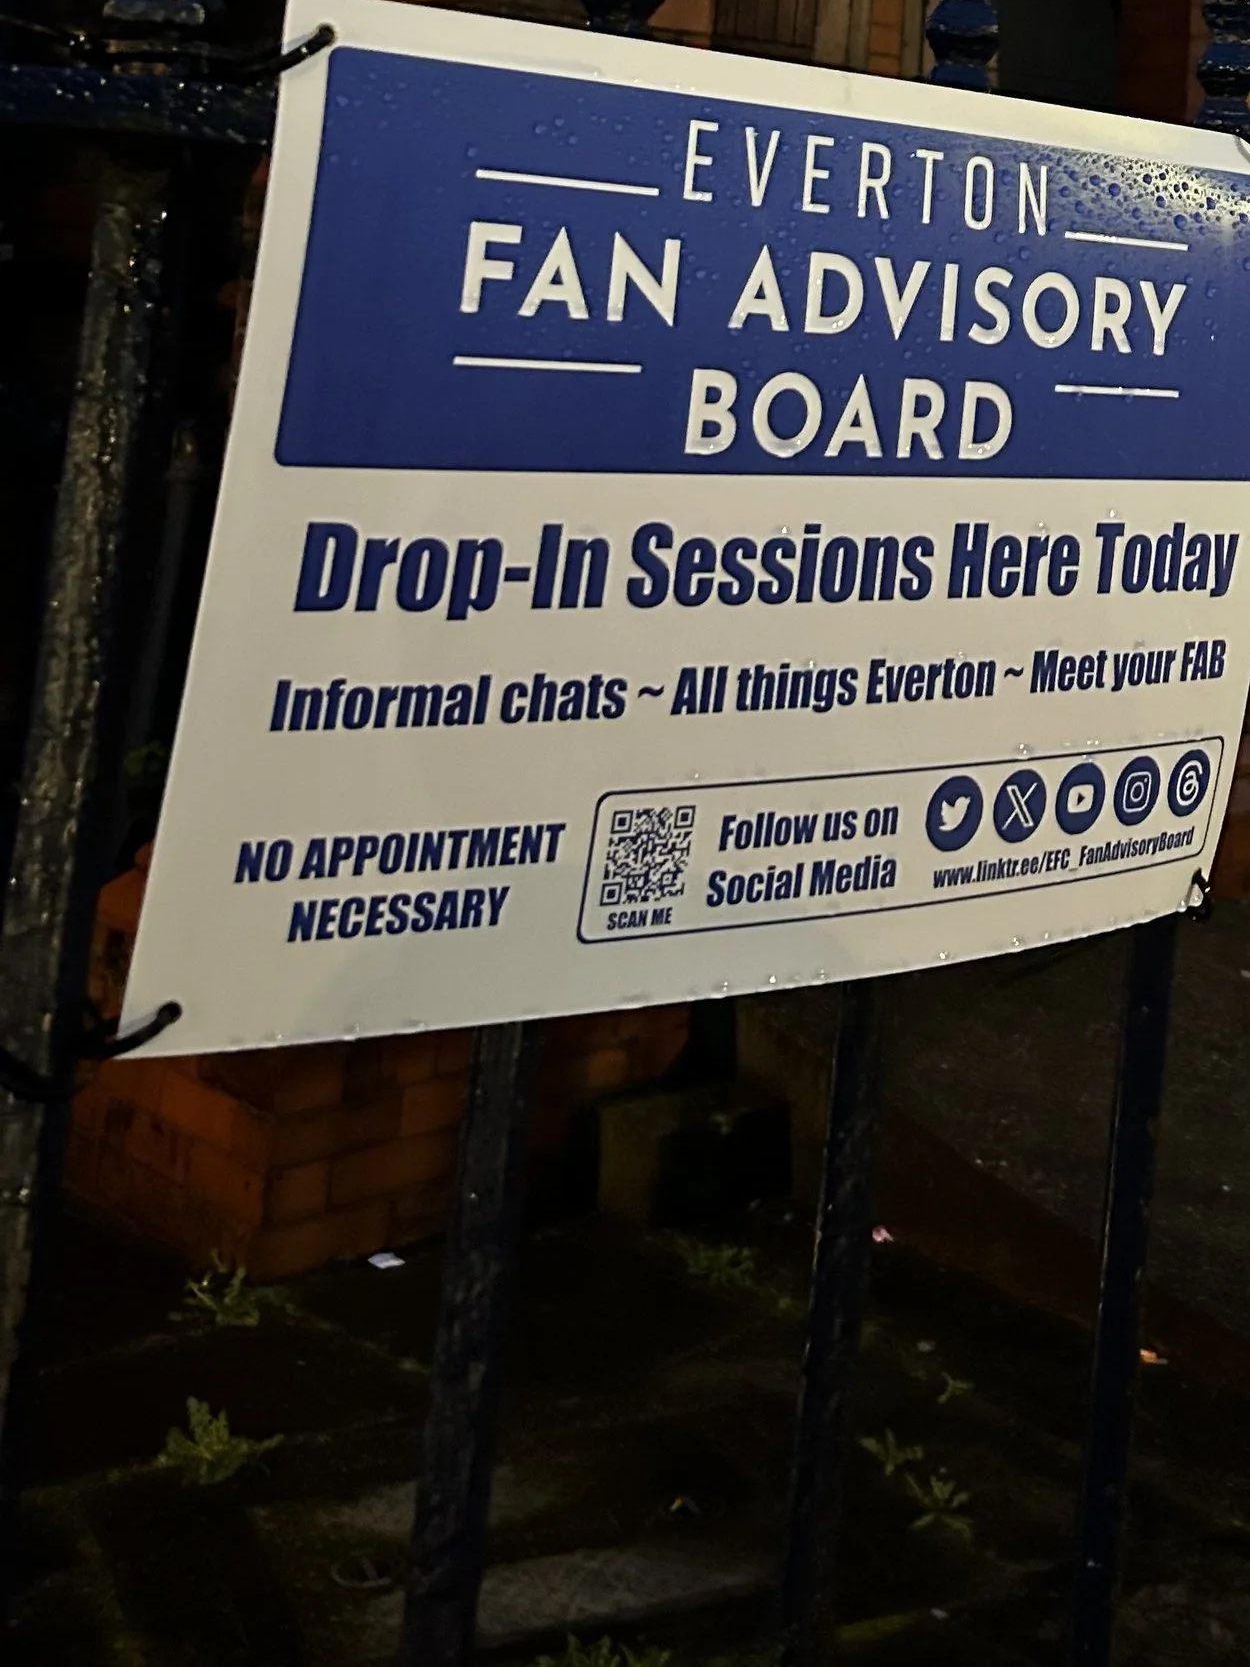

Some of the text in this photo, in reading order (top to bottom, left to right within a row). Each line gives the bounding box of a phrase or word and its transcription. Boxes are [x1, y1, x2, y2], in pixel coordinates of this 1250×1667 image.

[683, 120, 1050, 236] EVERTON
[460, 222, 1188, 356] FAN ADVISORY
[685, 369, 1013, 460] BOARD
[293, 521, 1240, 621] Drop-In Sessions Here Today
[269, 674, 491, 733] Informal
[500, 673, 627, 725] chats
[670, 666, 727, 716] All
[736, 662, 859, 714] things
[866, 657, 997, 705] Everton
[1030, 649, 1107, 694] Meet
[1109, 649, 1177, 693] your
[1180, 639, 1227, 683] FAB
[234, 822, 567, 884] NO APPOINTMENT
[718, 806, 899, 853] Follow us on
[932, 826, 1196, 890] www.linktr.ee/EFC_FanAdvisoryBoard
[706, 854, 898, 908] Social Media
[286, 885, 511, 944] NECESSARY
[606, 906, 673, 931] SCAN ME
